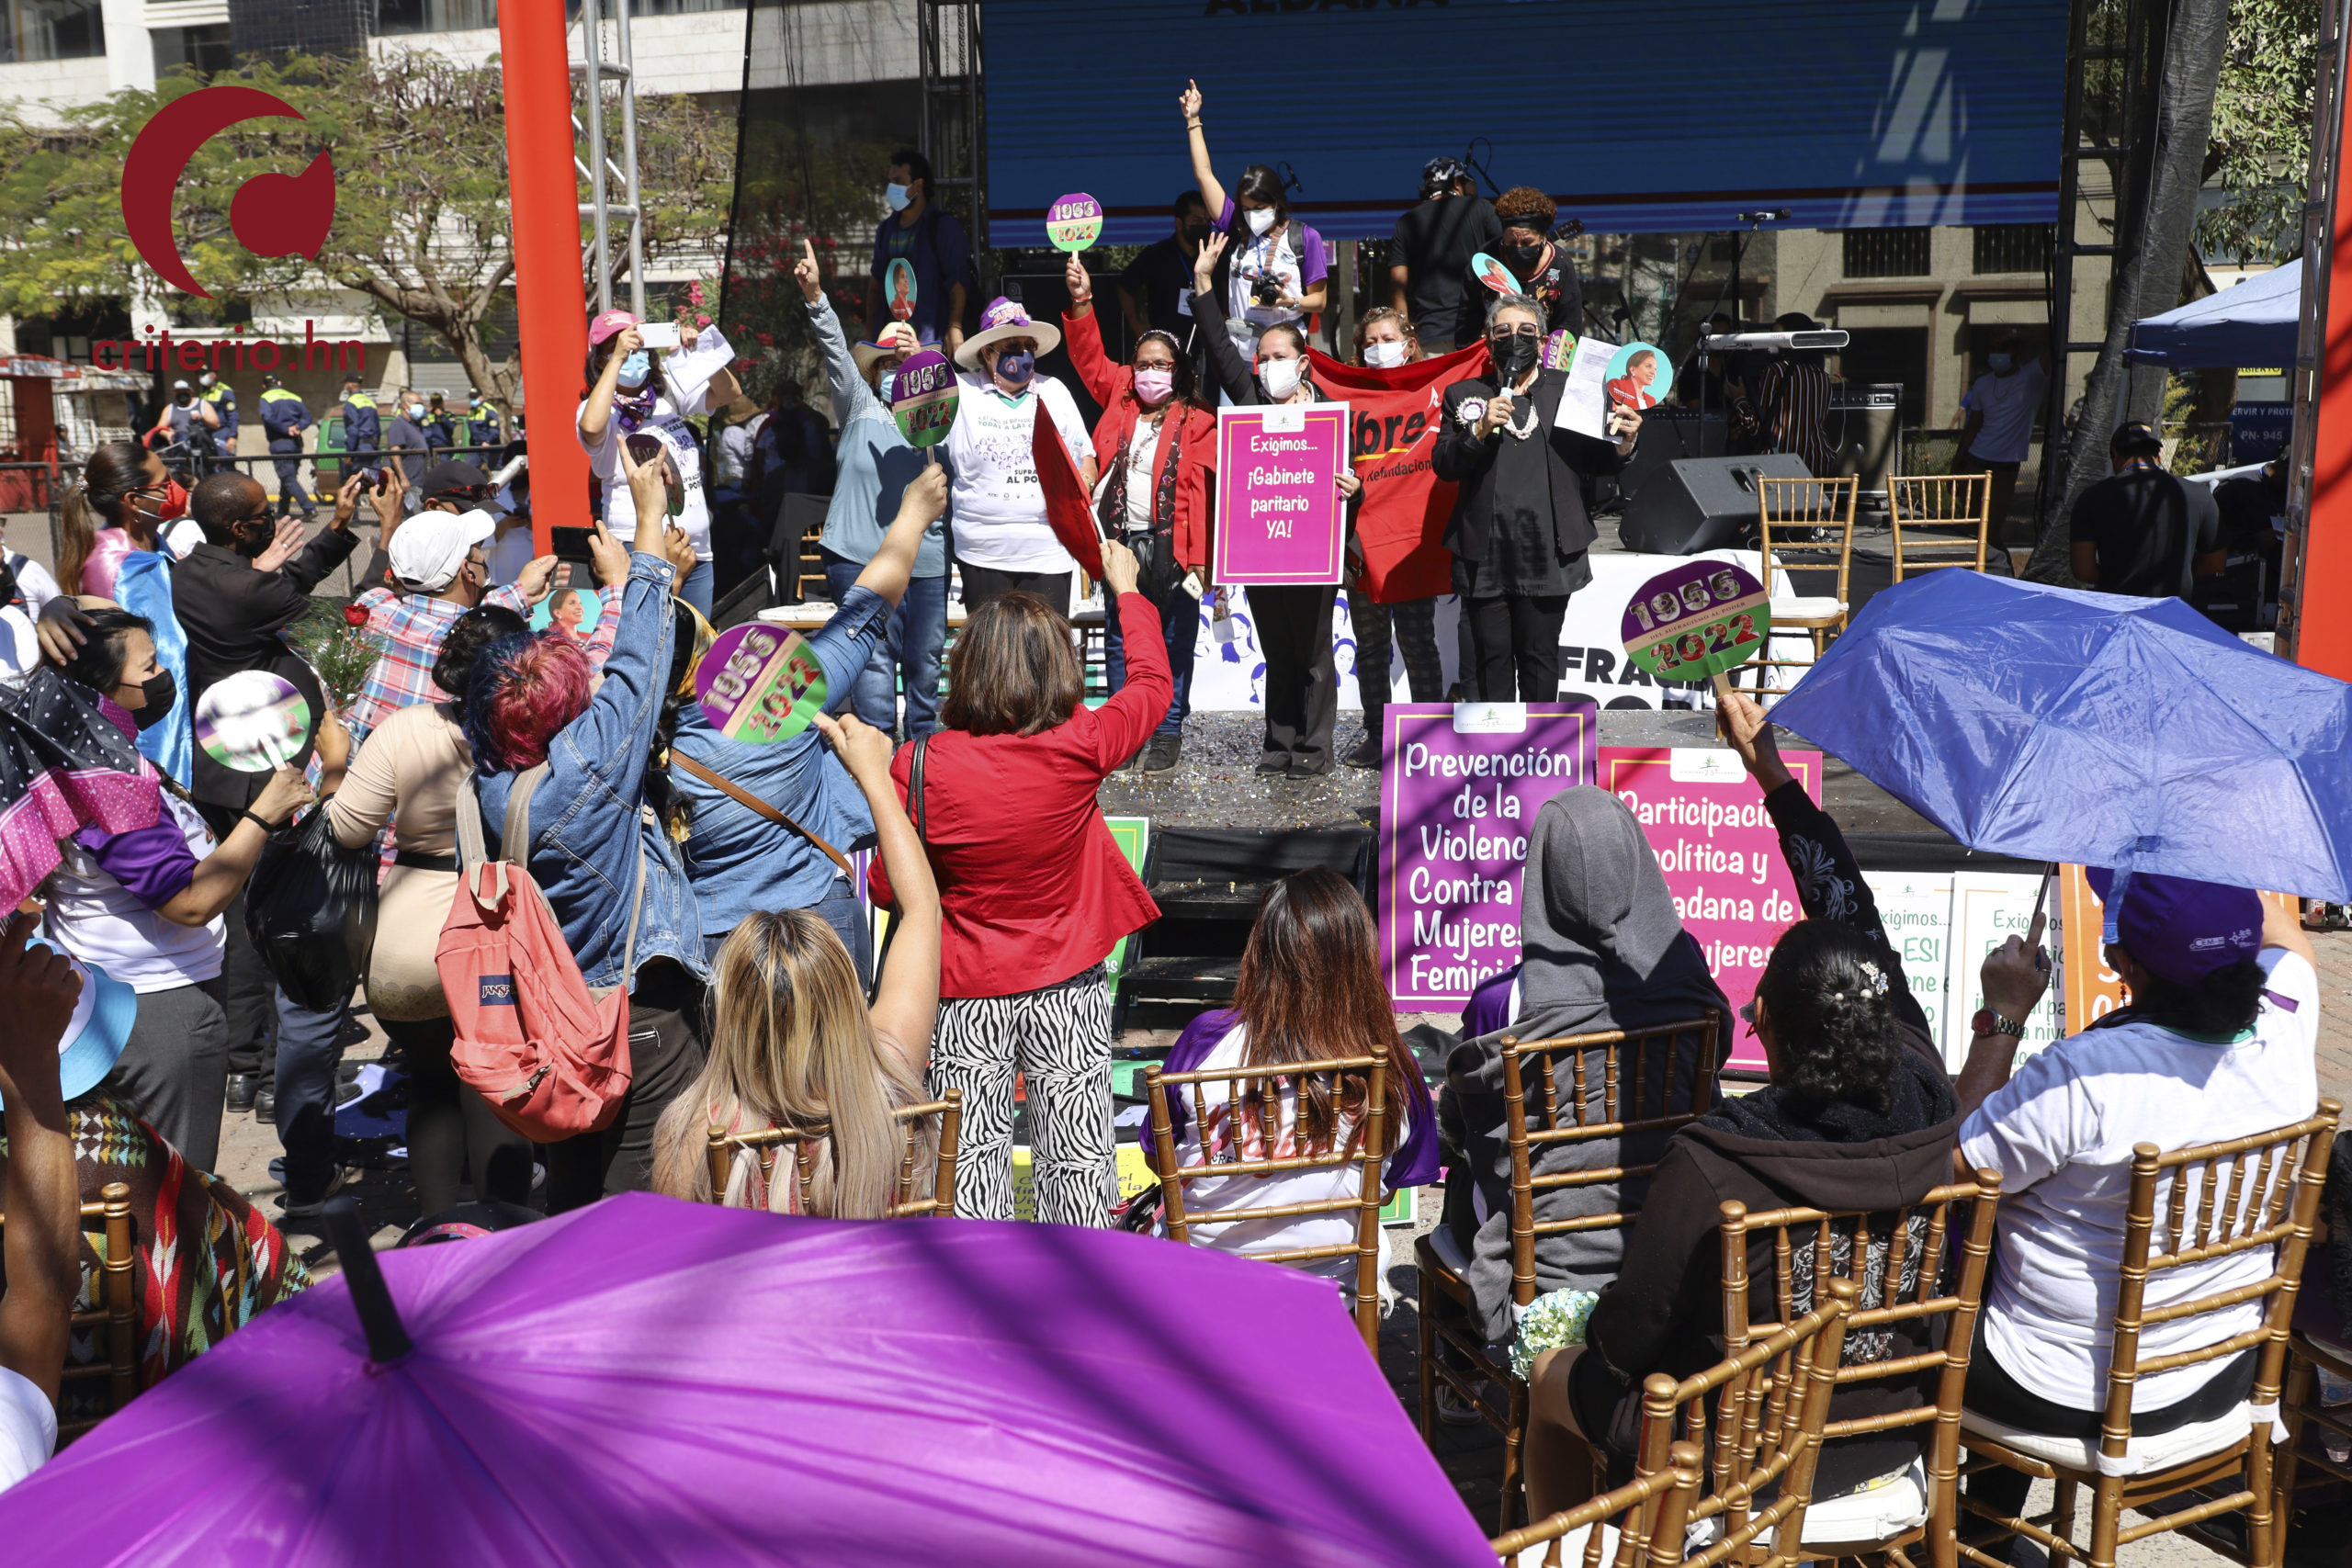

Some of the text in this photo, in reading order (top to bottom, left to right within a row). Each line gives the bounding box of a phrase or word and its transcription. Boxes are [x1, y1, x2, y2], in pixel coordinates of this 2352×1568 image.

[1053, 201, 1095, 220] 1955
[1055, 224, 1095, 243] 2022
[1560, 340, 1575, 370] 022
[900, 362, 948, 397] 1955
[905, 401, 952, 434] 2022
[2260, 407, 2267, 415] Y
[1250, 435, 1318, 457] Exigimos...
[2263, 431, 2283, 440] 945
[1247, 466, 1315, 491] ¡Gabinete
[1250, 495, 1309, 519] paritario
[1266, 520, 1293, 539] YA!
[1630, 569, 1741, 632] 1955
[1650, 632, 1663, 641] DEL
[1664, 615, 1709, 635] SUFRAGISMO
[1722, 602, 1747, 614] PODER
[1650, 614, 1760, 674] 2022
[700, 626, 777, 715] 1955
[748, 657, 821, 741] 2022
[1405, 742, 1572, 777] Prevención
[1453, 783, 1521, 819] de la
[1420, 824, 1527, 861] Violenc
[1752, 852, 1768, 885] y
[1409, 866, 1512, 906] Contra
[1669, 886, 1793, 921] adana de
[1994, 909, 2064, 934] Exigo
[1904, 937, 1940, 963] ESI
[1410, 953, 1521, 992] Femi
